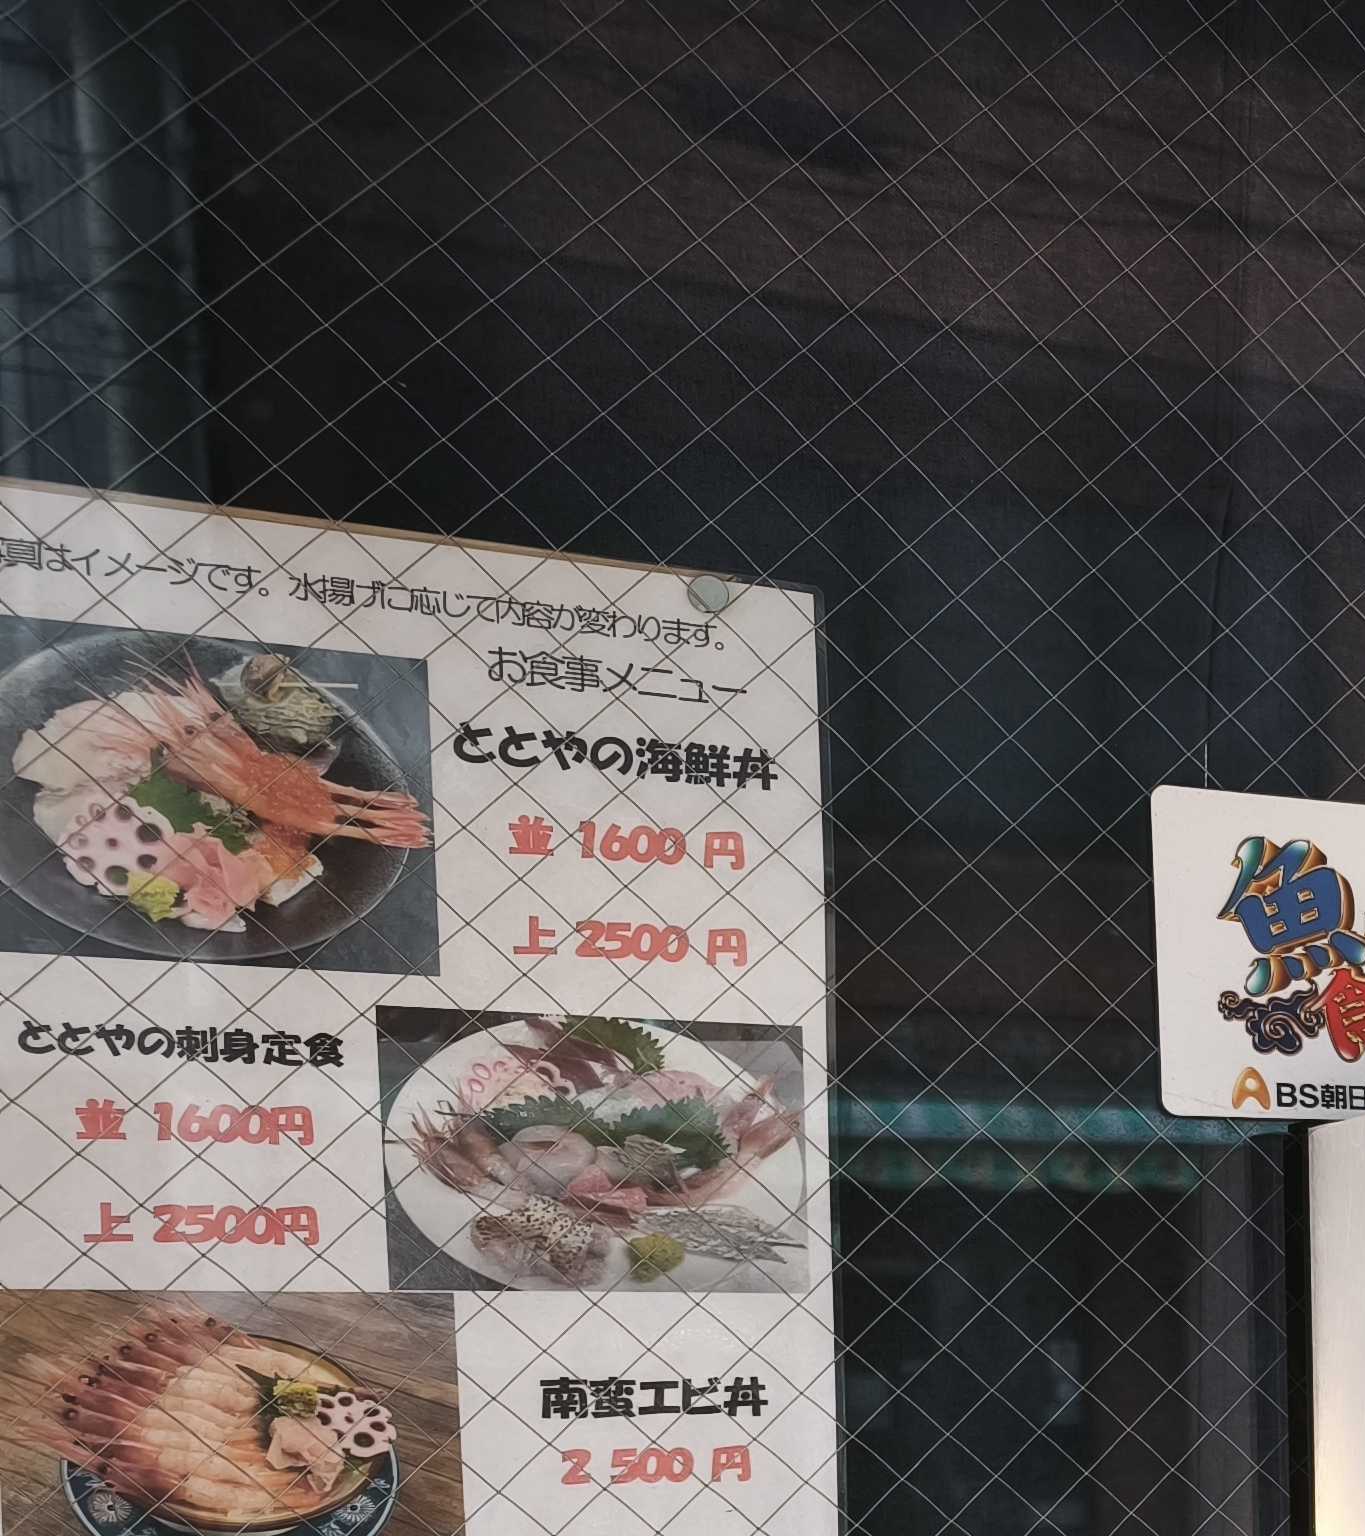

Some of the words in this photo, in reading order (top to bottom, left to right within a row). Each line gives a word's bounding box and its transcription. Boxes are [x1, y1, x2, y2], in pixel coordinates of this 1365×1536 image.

[0, 536, 270, 597] 真はイメージです。
[487, 646, 748, 705] お食事メニュー
[452, 722, 779, 792] ととやの海鮮丼
[17, 1020, 345, 1069] ととやの刺身定食
[539, 1376, 770, 1420] 南蛮エビ丼
